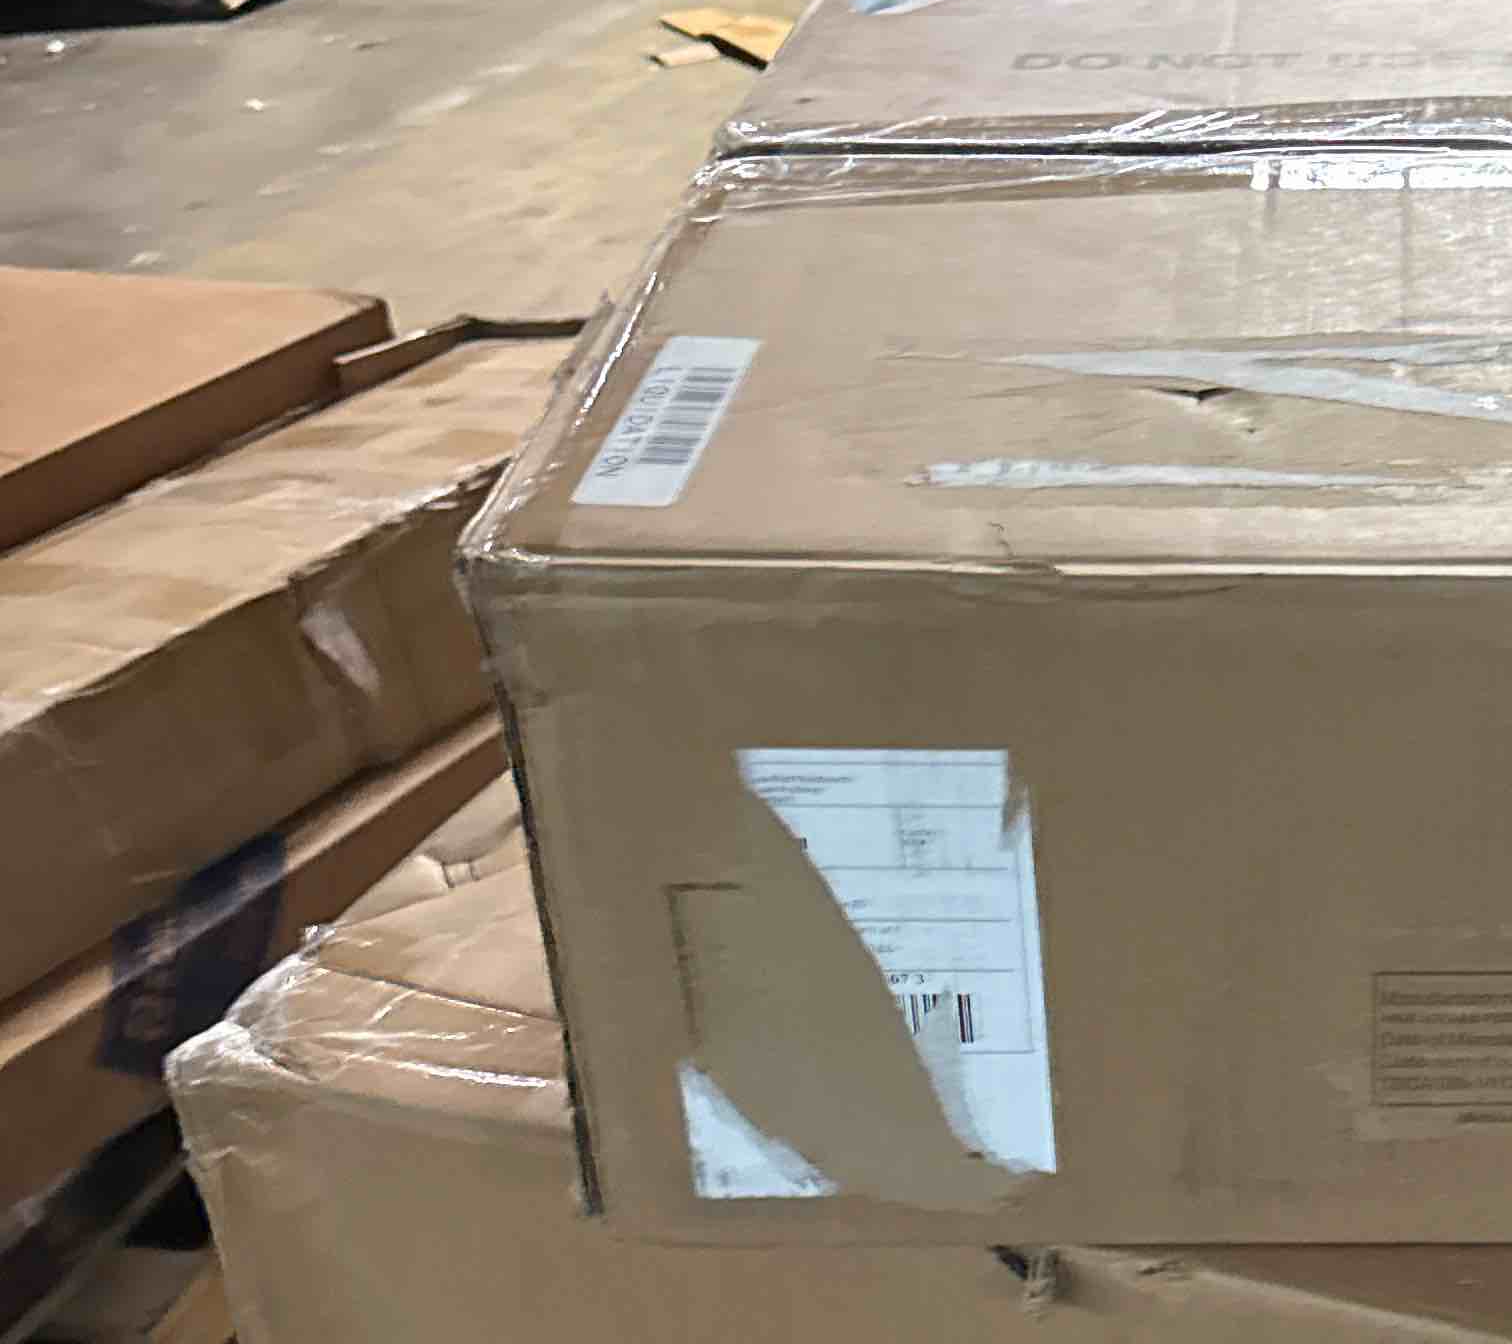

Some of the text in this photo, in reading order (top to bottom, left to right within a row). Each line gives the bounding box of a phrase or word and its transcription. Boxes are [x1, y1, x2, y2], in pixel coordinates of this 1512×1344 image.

[1010, 52, 1123, 71] DO
[1144, 52, 1304, 71] NOT
[595, 366, 683, 478] LIQUIDATION
